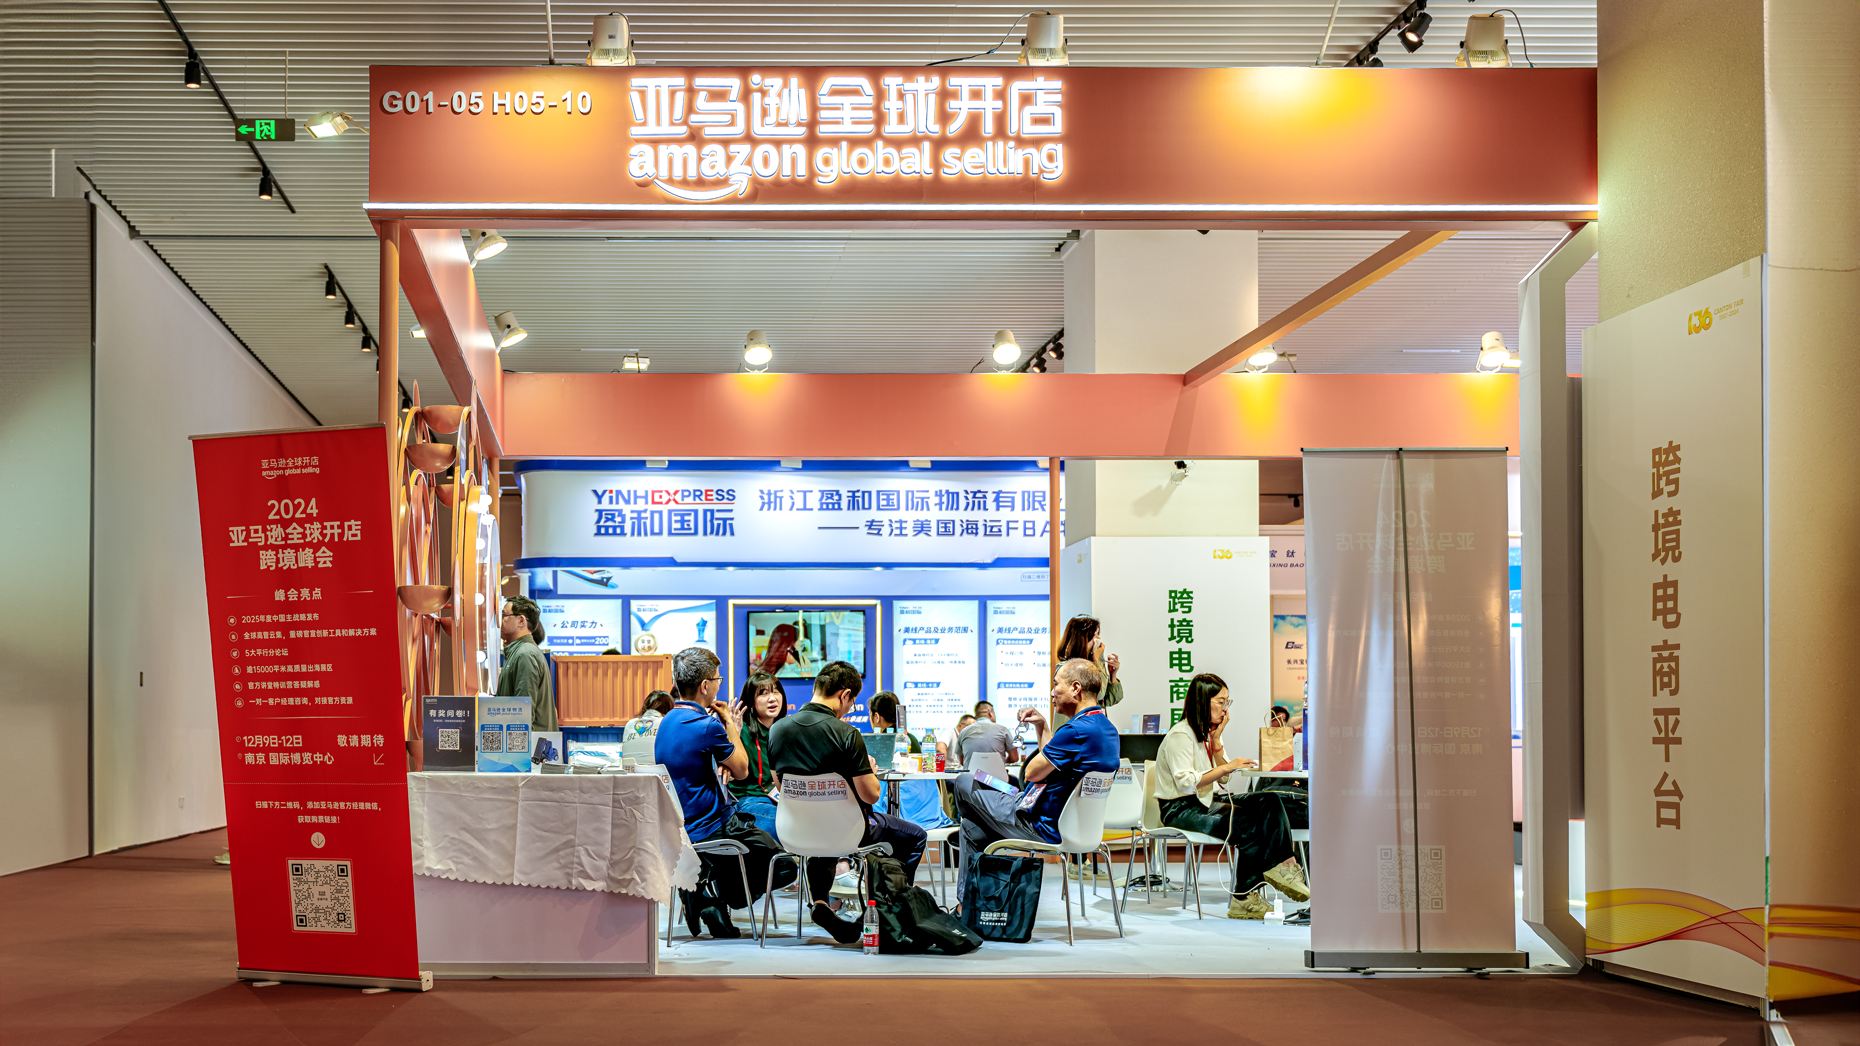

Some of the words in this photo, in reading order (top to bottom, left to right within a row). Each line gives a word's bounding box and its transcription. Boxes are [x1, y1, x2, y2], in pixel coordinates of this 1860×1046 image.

[381, 90, 485, 116] G01-05
[492, 90, 593, 116] H05-10
[628, 74, 1064, 138] 亚马逊全球开店
[628, 140, 807, 180] amazon
[814, 140, 933, 185] global
[940, 140, 1064, 183] selling
[261, 456, 320, 469] 亚马逊全球开店
[262, 469, 284, 477] amazon
[284, 468, 301, 476] global
[301, 466, 320, 475] selling
[757, 489, 1064, 512] 浙江盈和国际物流有限
[267, 497, 319, 520] 2024
[593, 508, 736, 537] 盈和国际
[228, 519, 362, 547] 亚马逊全球开店
[259, 545, 334, 571] 跨境峰会
[1212, 548, 1233, 560] 136
[274, 587, 323, 602] 峰会亮点
[560, 620, 598, 629] 公司实力
[903, 626, 969, 634] 美线产品及业务范围
[996, 626, 1051, 634] 美线产品及业务
[595, 637, 609, 645] 200
[1650, 440, 1685, 830] 跨境电商平台
[245, 648, 289, 657] 5大平行分论坛
[242, 735, 303, 747] 12月9日-12日
[337, 734, 385, 747] 敬请期待
[244, 752, 267, 765] 南京
[268, 752, 335, 765] 国际博览中心
[783, 778, 847, 790] 亚马逊全球开店
[784, 788, 807, 796] amazon
[808, 790, 826, 798] global
